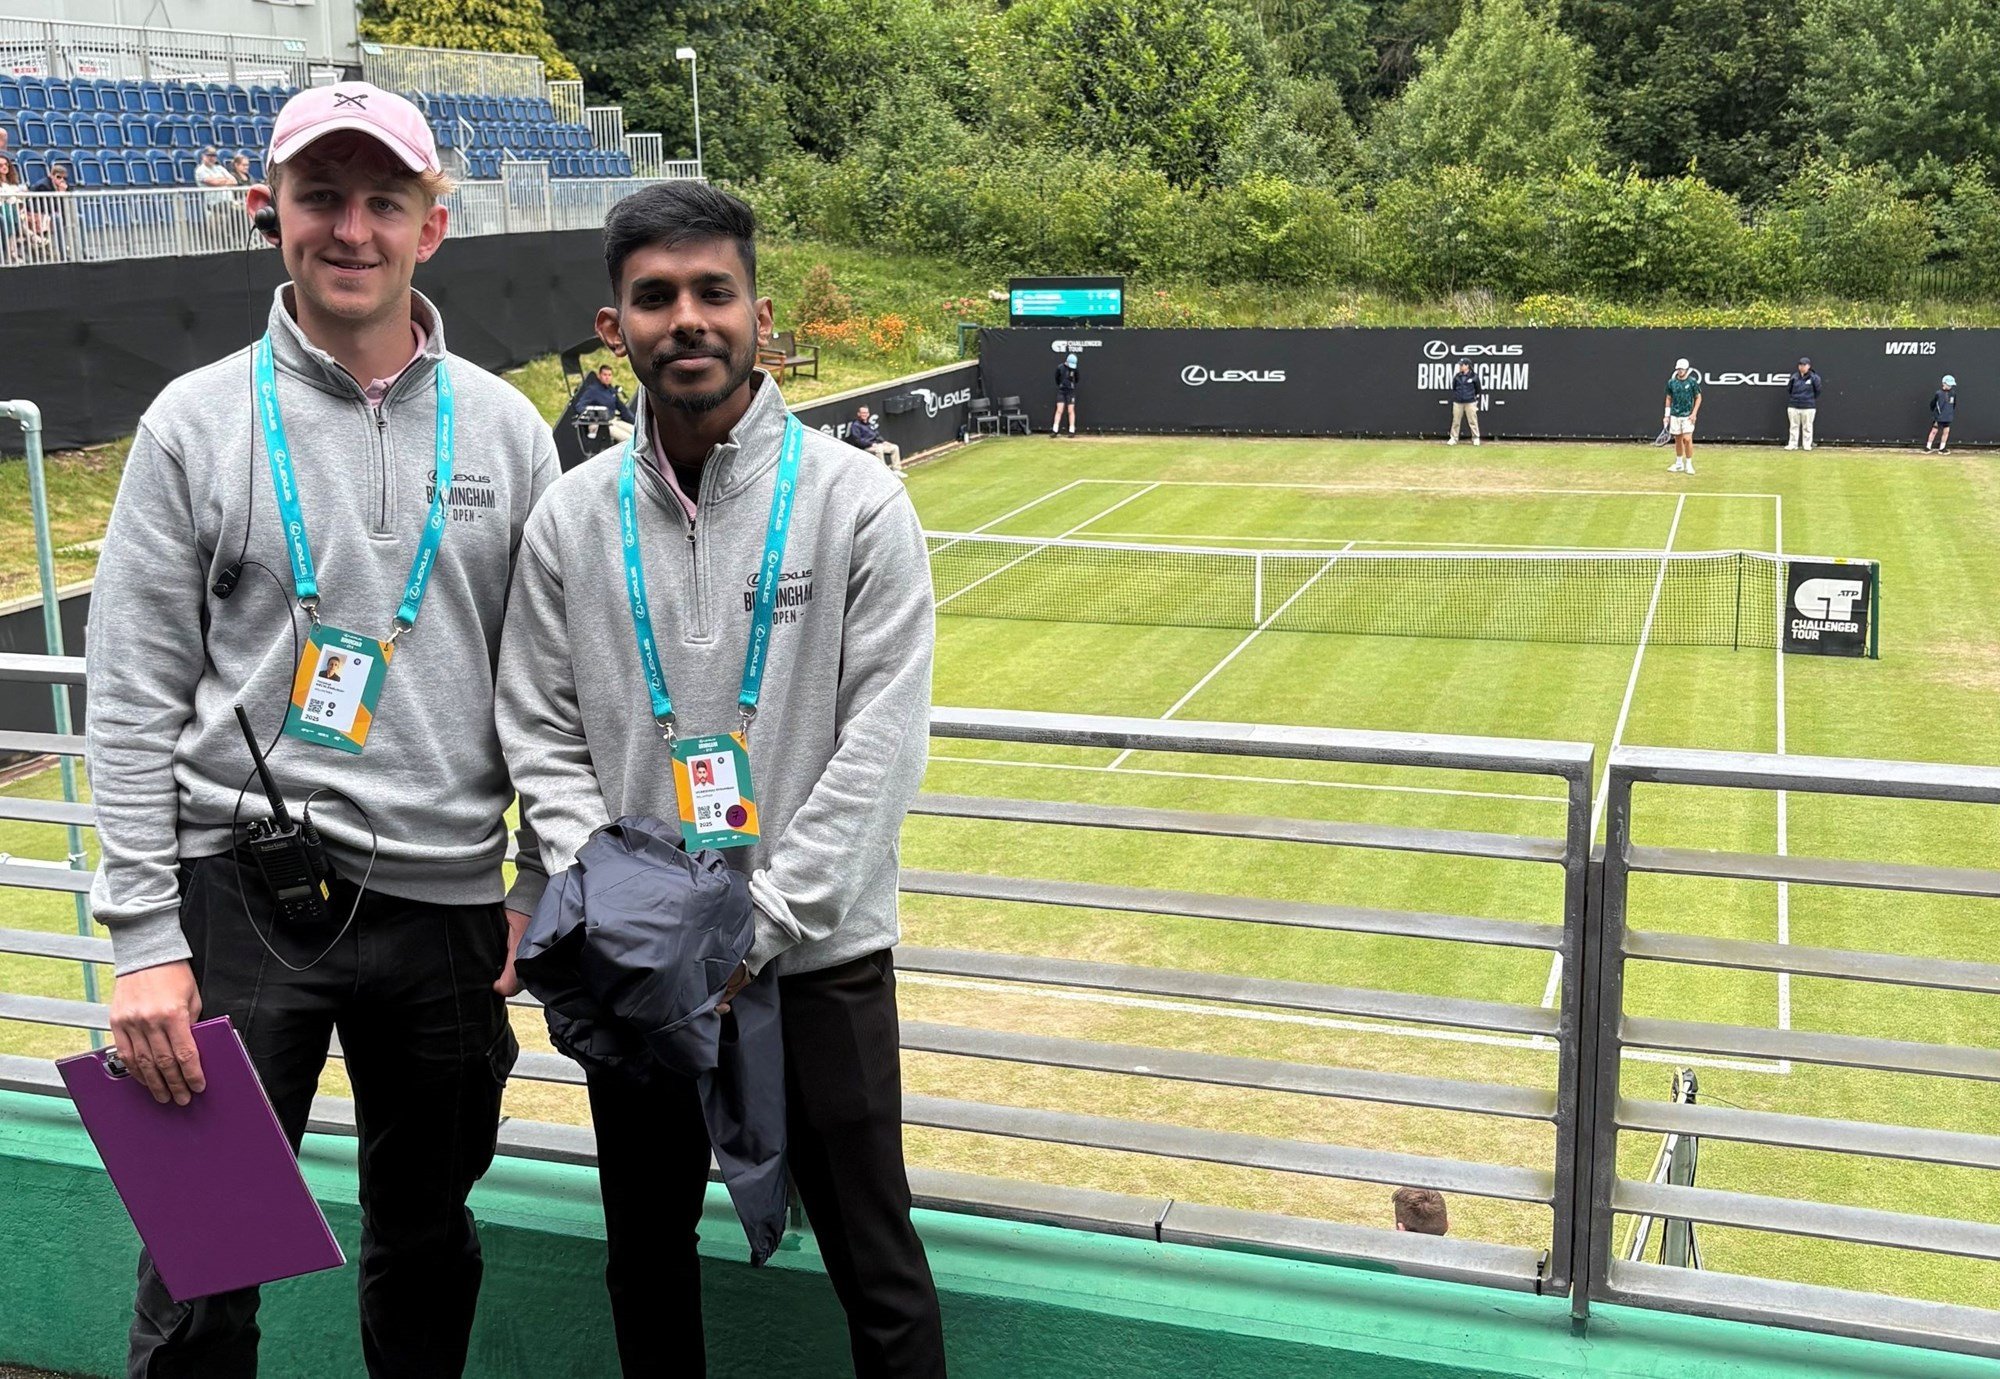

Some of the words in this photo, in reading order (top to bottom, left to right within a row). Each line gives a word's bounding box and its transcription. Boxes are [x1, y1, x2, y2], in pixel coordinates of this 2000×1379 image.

[1451, 345, 1523, 355] LEXUS
[1886, 342, 1918, 355] WTA
[1920, 342, 1936, 355] 125
[1209, 370, 1286, 382] LEXUS
[1417, 363, 1529, 390] BIRMGHAM
[1705, 373, 1791, 386] LEXUS
[938, 388, 971, 411] LEXUS
[265, 399, 277, 432] LEXUS
[276, 462, 292, 501] LEXUS
[451, 474, 490, 483] EXUS
[453, 509, 474, 522] OPEN
[775, 494, 788, 531] LEXUS
[294, 535, 308, 576] LEXUS
[417, 549, 431, 588] LEXUS
[778, 569, 812, 582] EXUS
[628, 566, 640, 606] LEXUS
[762, 565, 775, 604] LEXUS
[773, 610, 796, 625] OPEN
[1791, 619, 1859, 633] CHALLENGER
[1791, 629, 1819, 640] TOUR
[643, 638, 656, 676] LEXUS
[750, 637, 761, 677] LEXUS
